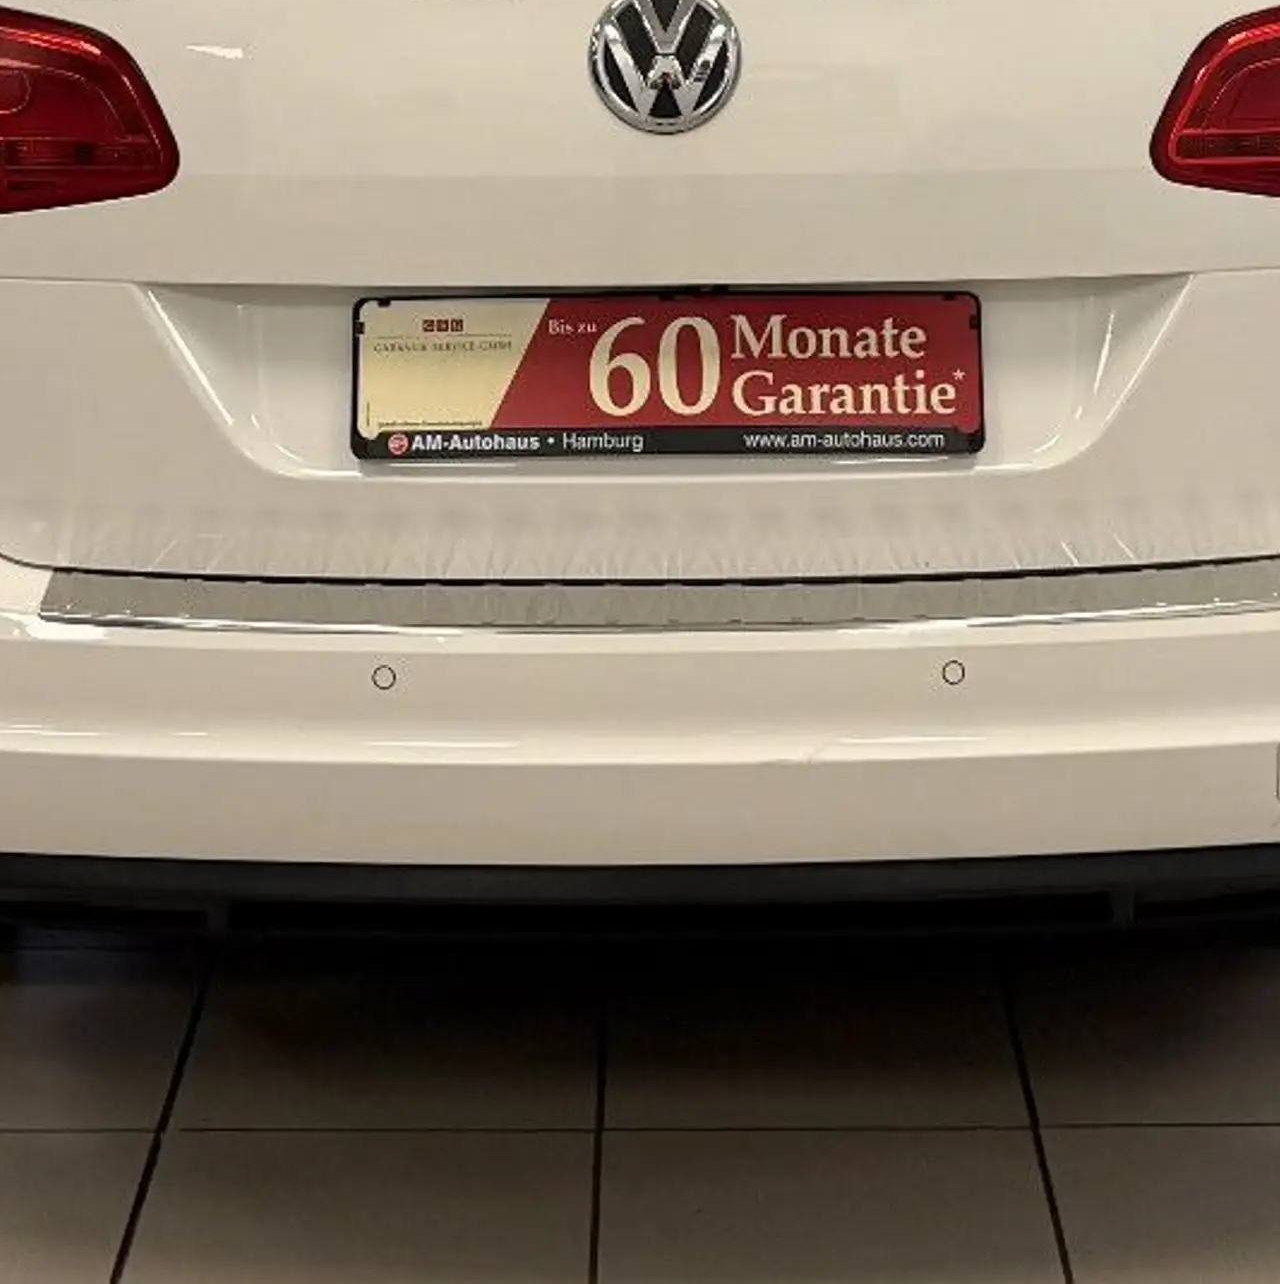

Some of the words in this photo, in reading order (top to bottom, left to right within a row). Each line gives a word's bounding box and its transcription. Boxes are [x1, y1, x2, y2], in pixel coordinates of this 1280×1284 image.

[548, 319, 573, 334] Bis
[577, 321, 598, 333] zu
[731, 314, 928, 360] Monate
[589, 316, 721, 417] 60
[410, 433, 540, 451] AM-Autohaus
[562, 432, 644, 452] Hamburg
[743, 430, 945, 449] www.am-autohaus.com
